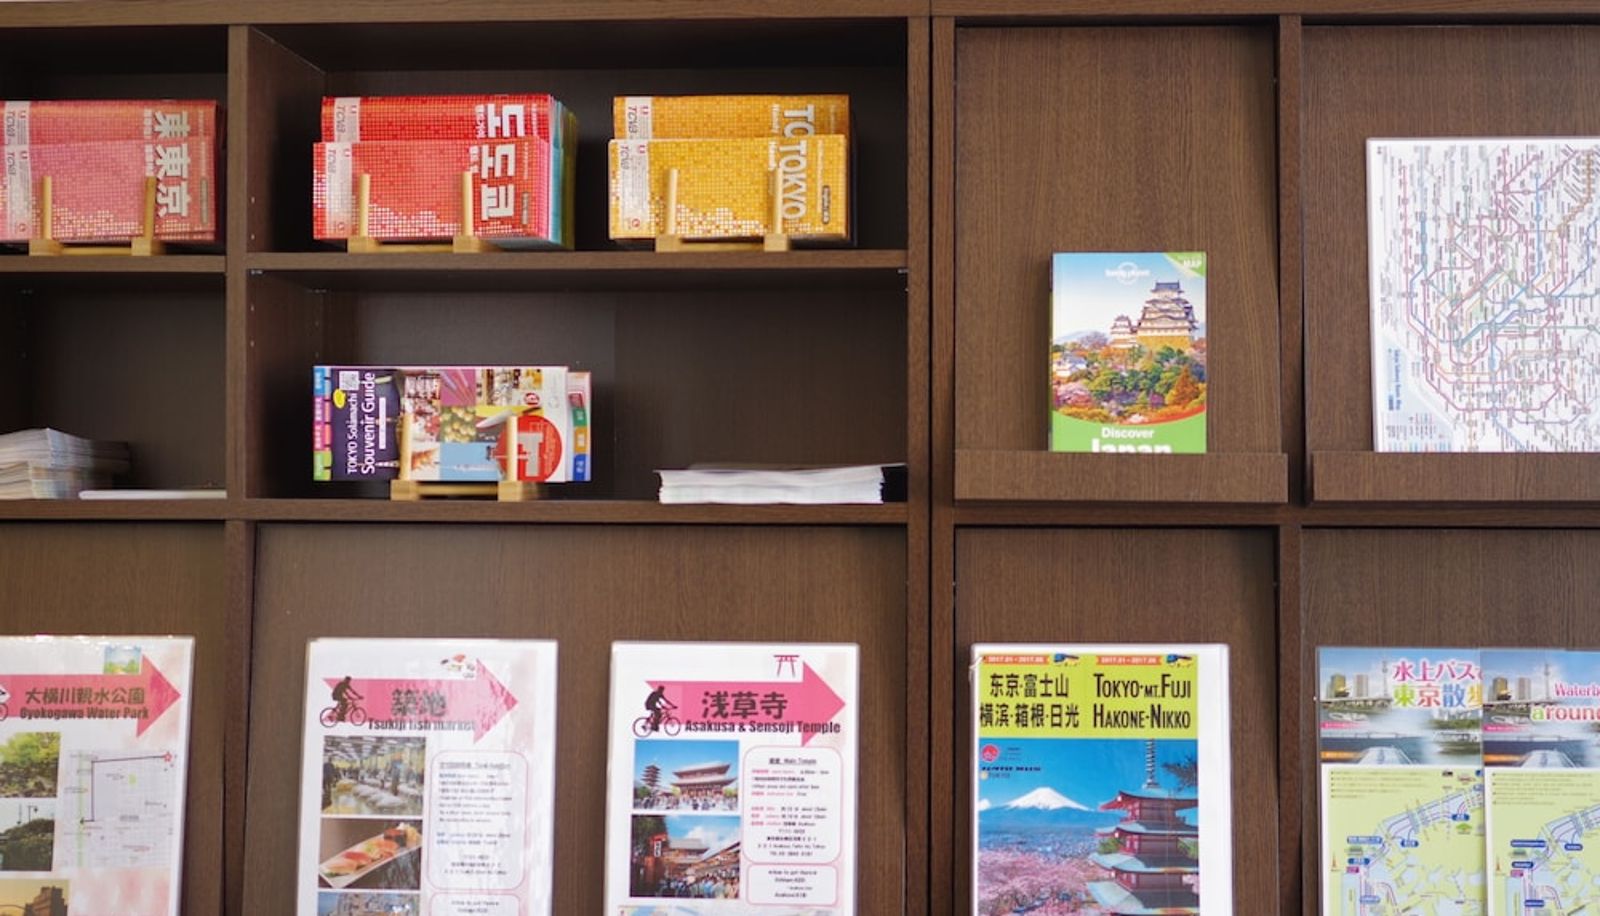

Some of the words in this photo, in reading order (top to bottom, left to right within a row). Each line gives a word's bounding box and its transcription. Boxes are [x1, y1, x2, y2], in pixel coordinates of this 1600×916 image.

[156, 143, 191, 217] 東京
[481, 143, 516, 221] 도쿄
[779, 141, 807, 220] TOKYO
[361, 372, 375, 412] Guide
[360, 415, 375, 474] Souvenir
[1101, 427, 1155, 439] Discover
[347, 441, 358, 474] TOKYO
[87, 707, 121, 719] Water
[124, 707, 149, 719] Park
[702, 691, 788, 719] 浅草寺
[685, 720, 735, 733] Asakusa
[738, 722, 747, 733] &
[749, 720, 793, 734] Sensoji
[797, 721, 841, 735] Temple
